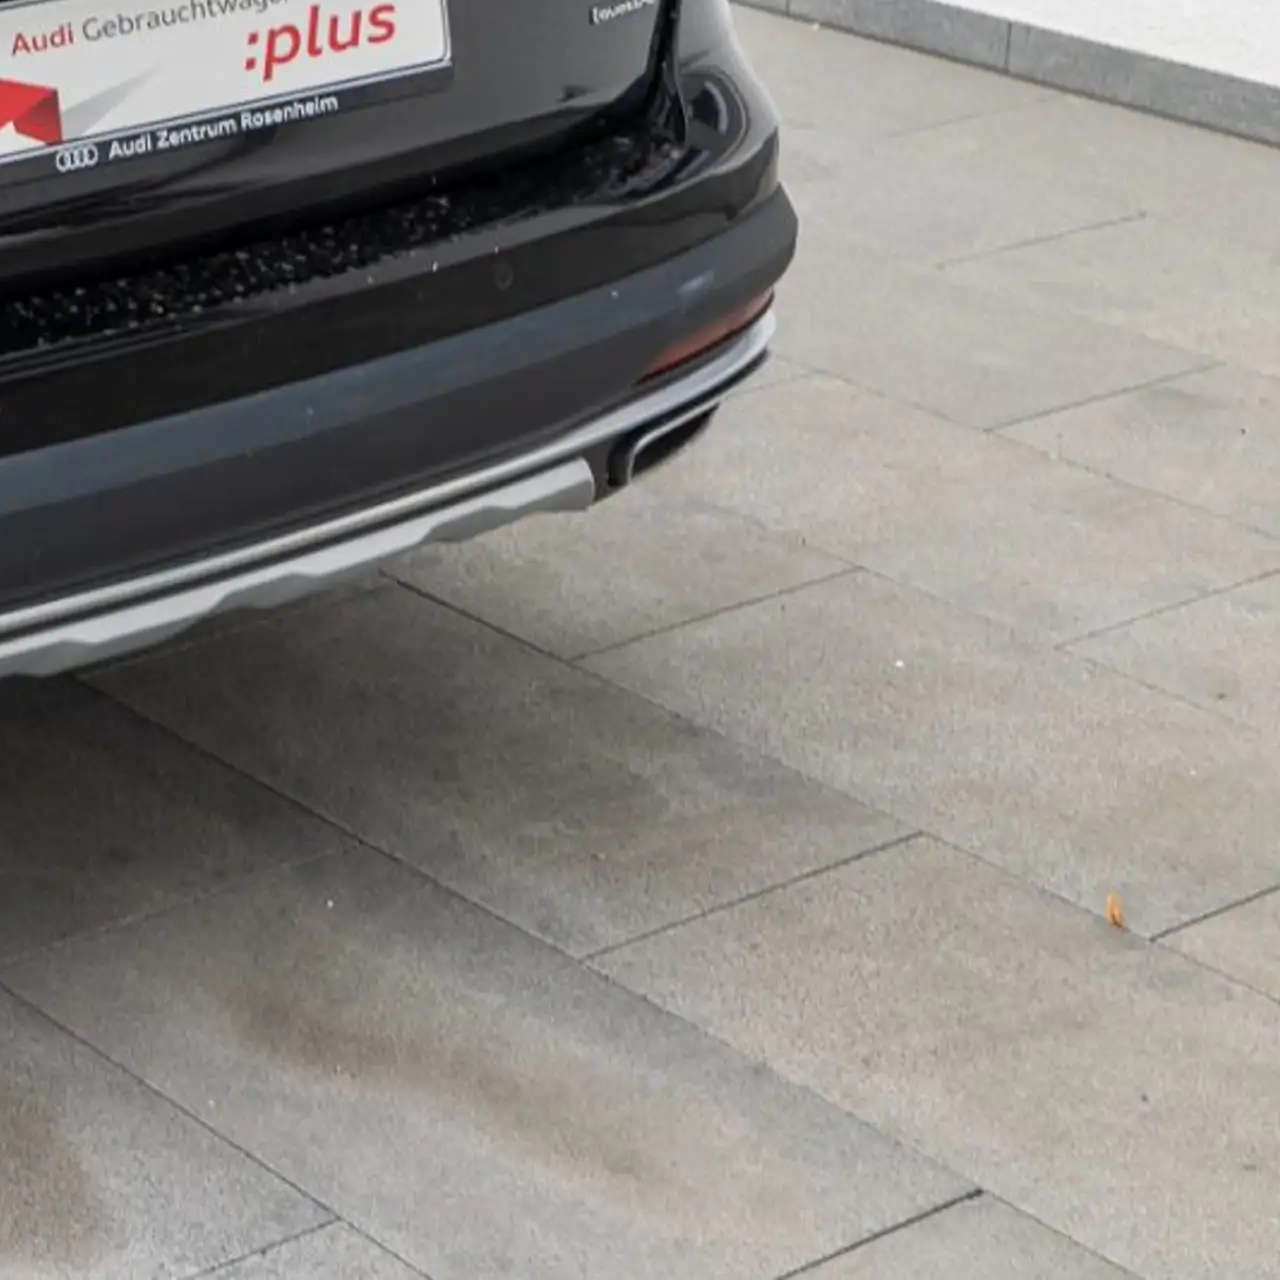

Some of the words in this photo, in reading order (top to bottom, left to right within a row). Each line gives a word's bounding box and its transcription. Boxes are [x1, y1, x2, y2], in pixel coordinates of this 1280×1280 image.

[11, 22, 74, 57] Audi
[245, 3, 396, 82] :plus
[108, 133, 152, 160] Audi
[157, 119, 237, 149] Zentrum
[241, 95, 339, 131] Rosenheim
